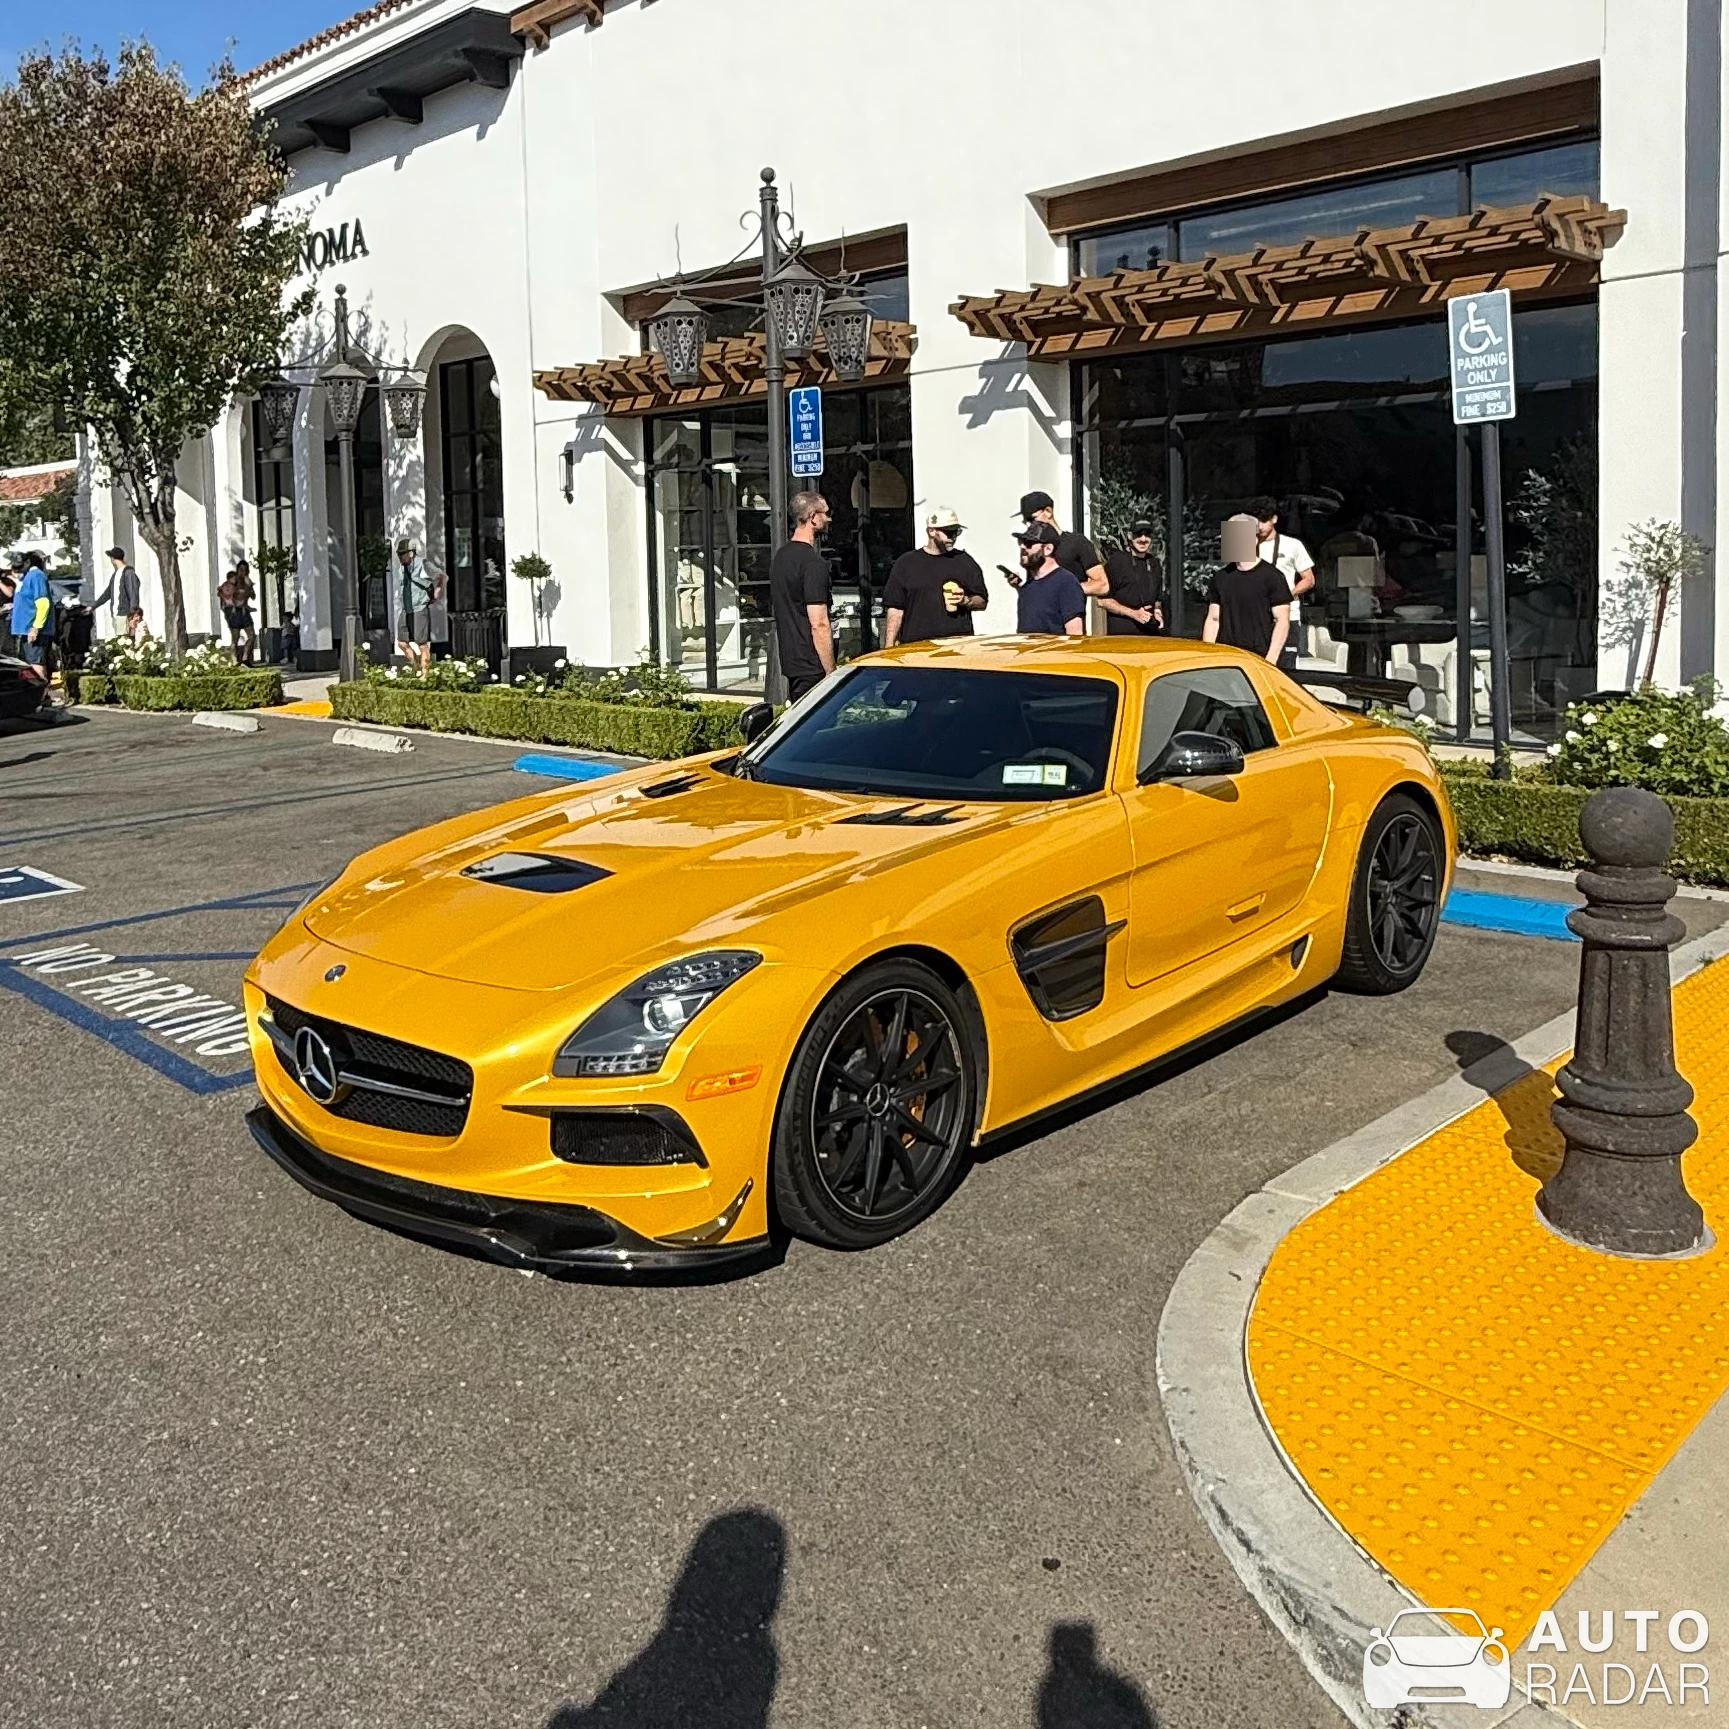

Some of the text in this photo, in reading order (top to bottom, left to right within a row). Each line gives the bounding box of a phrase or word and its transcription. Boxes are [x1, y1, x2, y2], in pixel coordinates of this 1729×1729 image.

[296, 217, 370, 277] NOMA
[1457, 351, 1507, 371] PARKING
[1467, 369, 1497, 384] ONLY
[1461, 401, 1507, 417] FINE $250
[12, 942, 116, 974] NO
[65, 967, 250, 1056] PARKING
